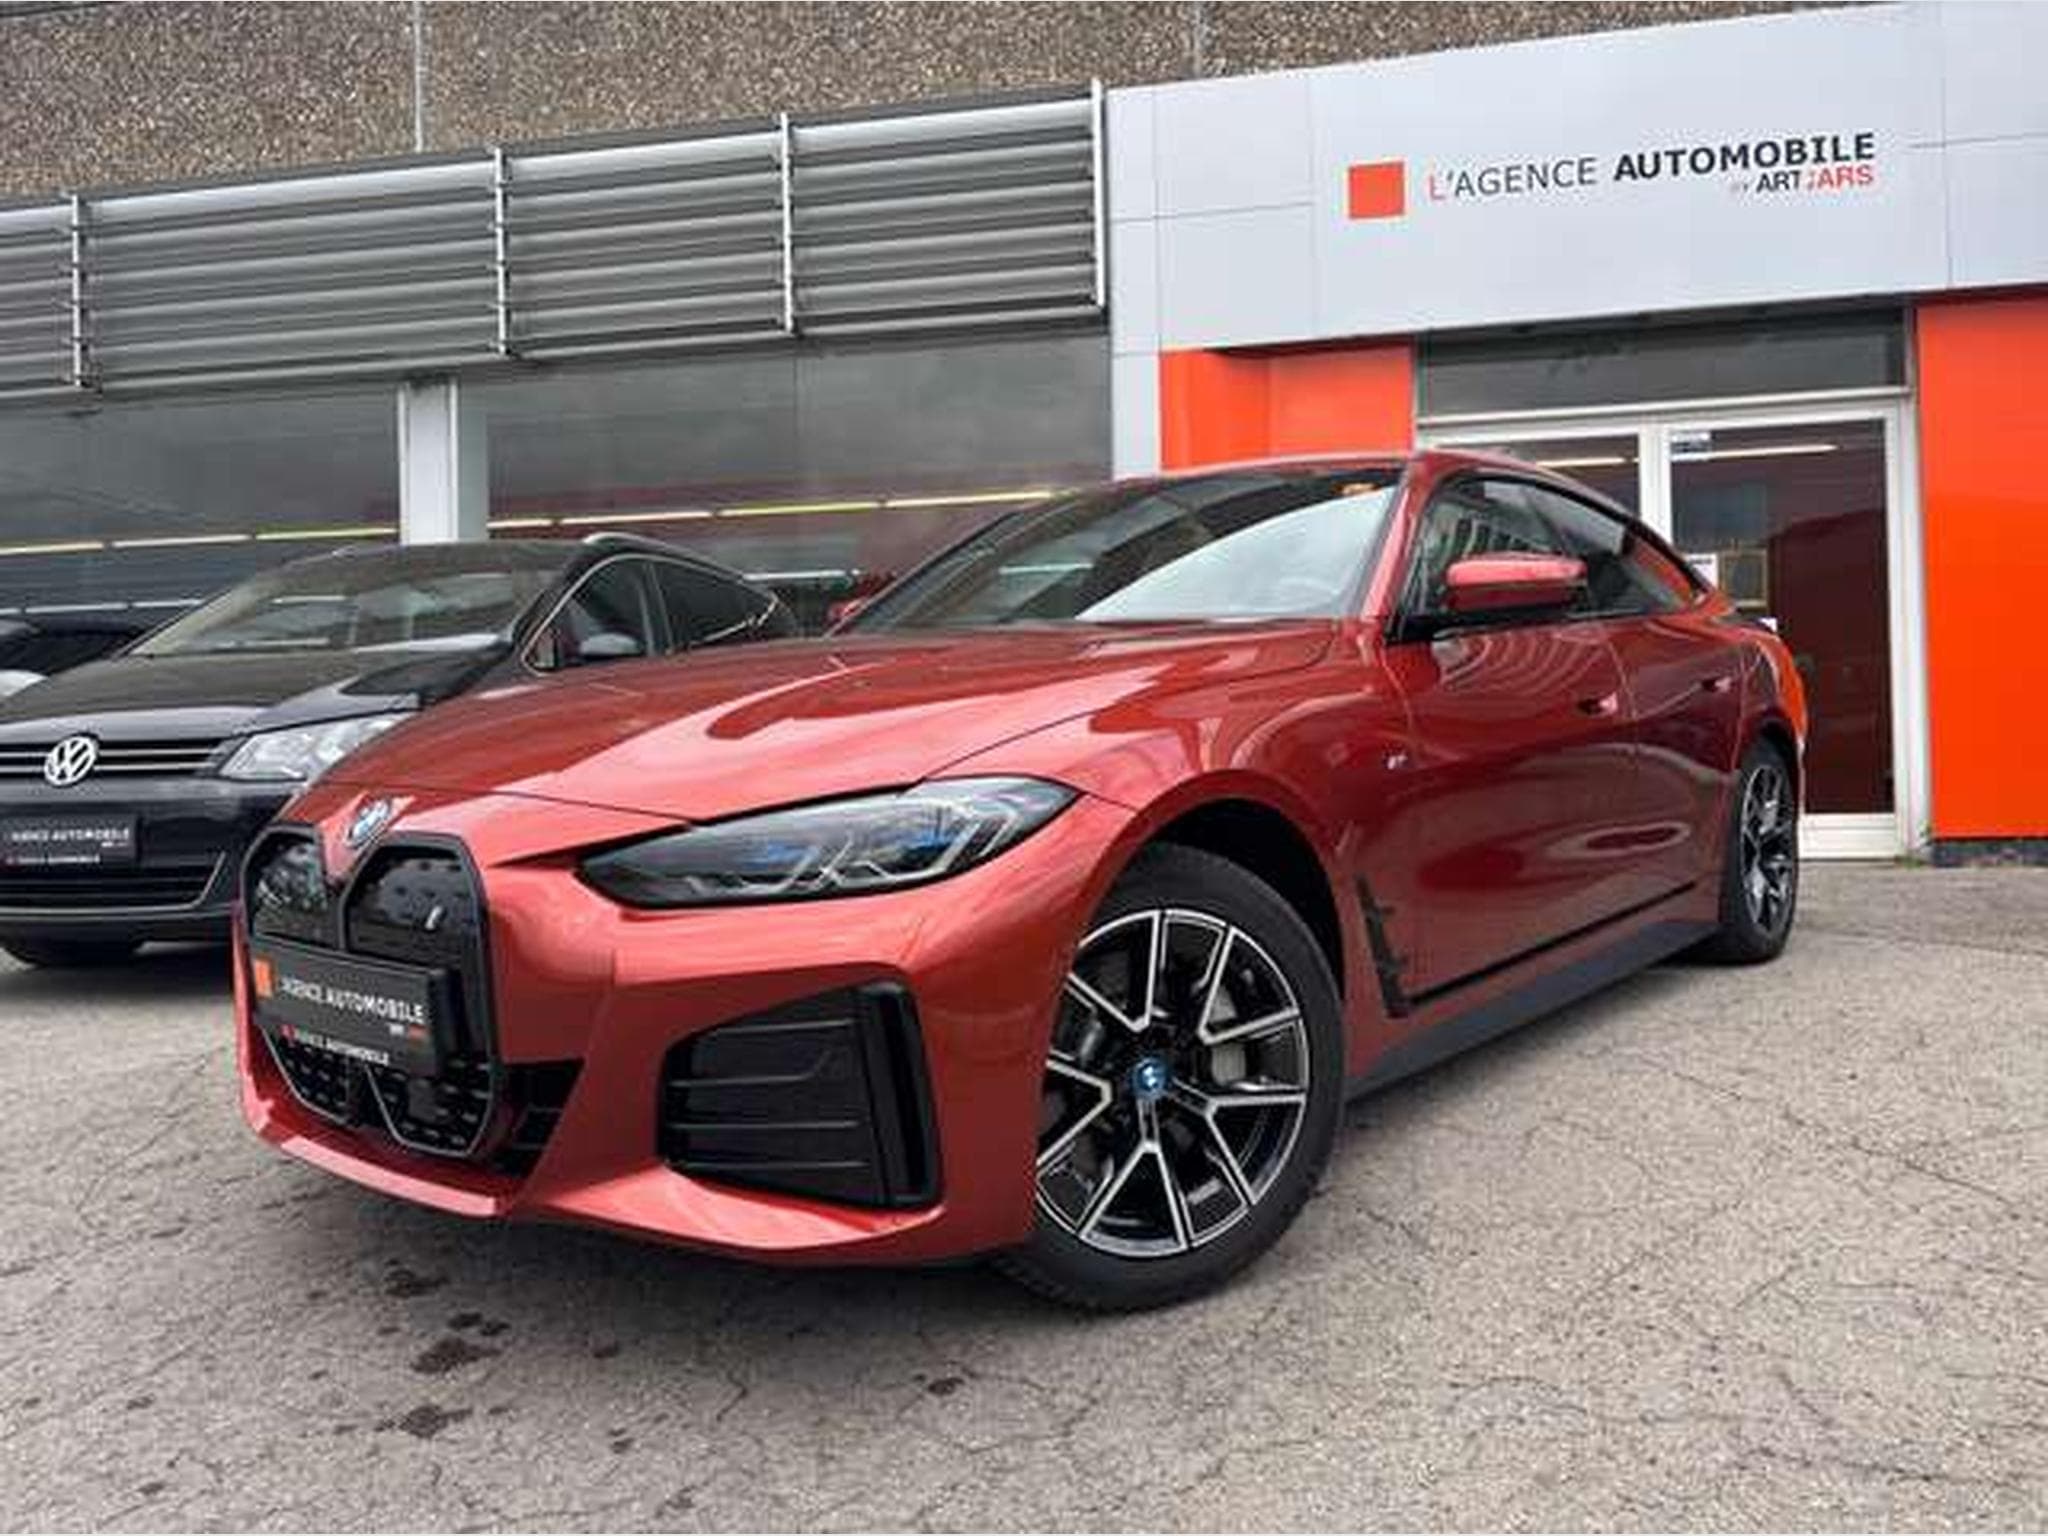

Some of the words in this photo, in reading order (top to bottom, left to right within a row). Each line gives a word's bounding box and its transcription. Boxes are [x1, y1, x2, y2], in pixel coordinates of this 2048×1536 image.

[1429, 157, 1598, 201] L'AGENCE
[1613, 132, 1875, 182] AUTOMOBILE
[326, 986, 425, 1024] AUTOMOBILE
